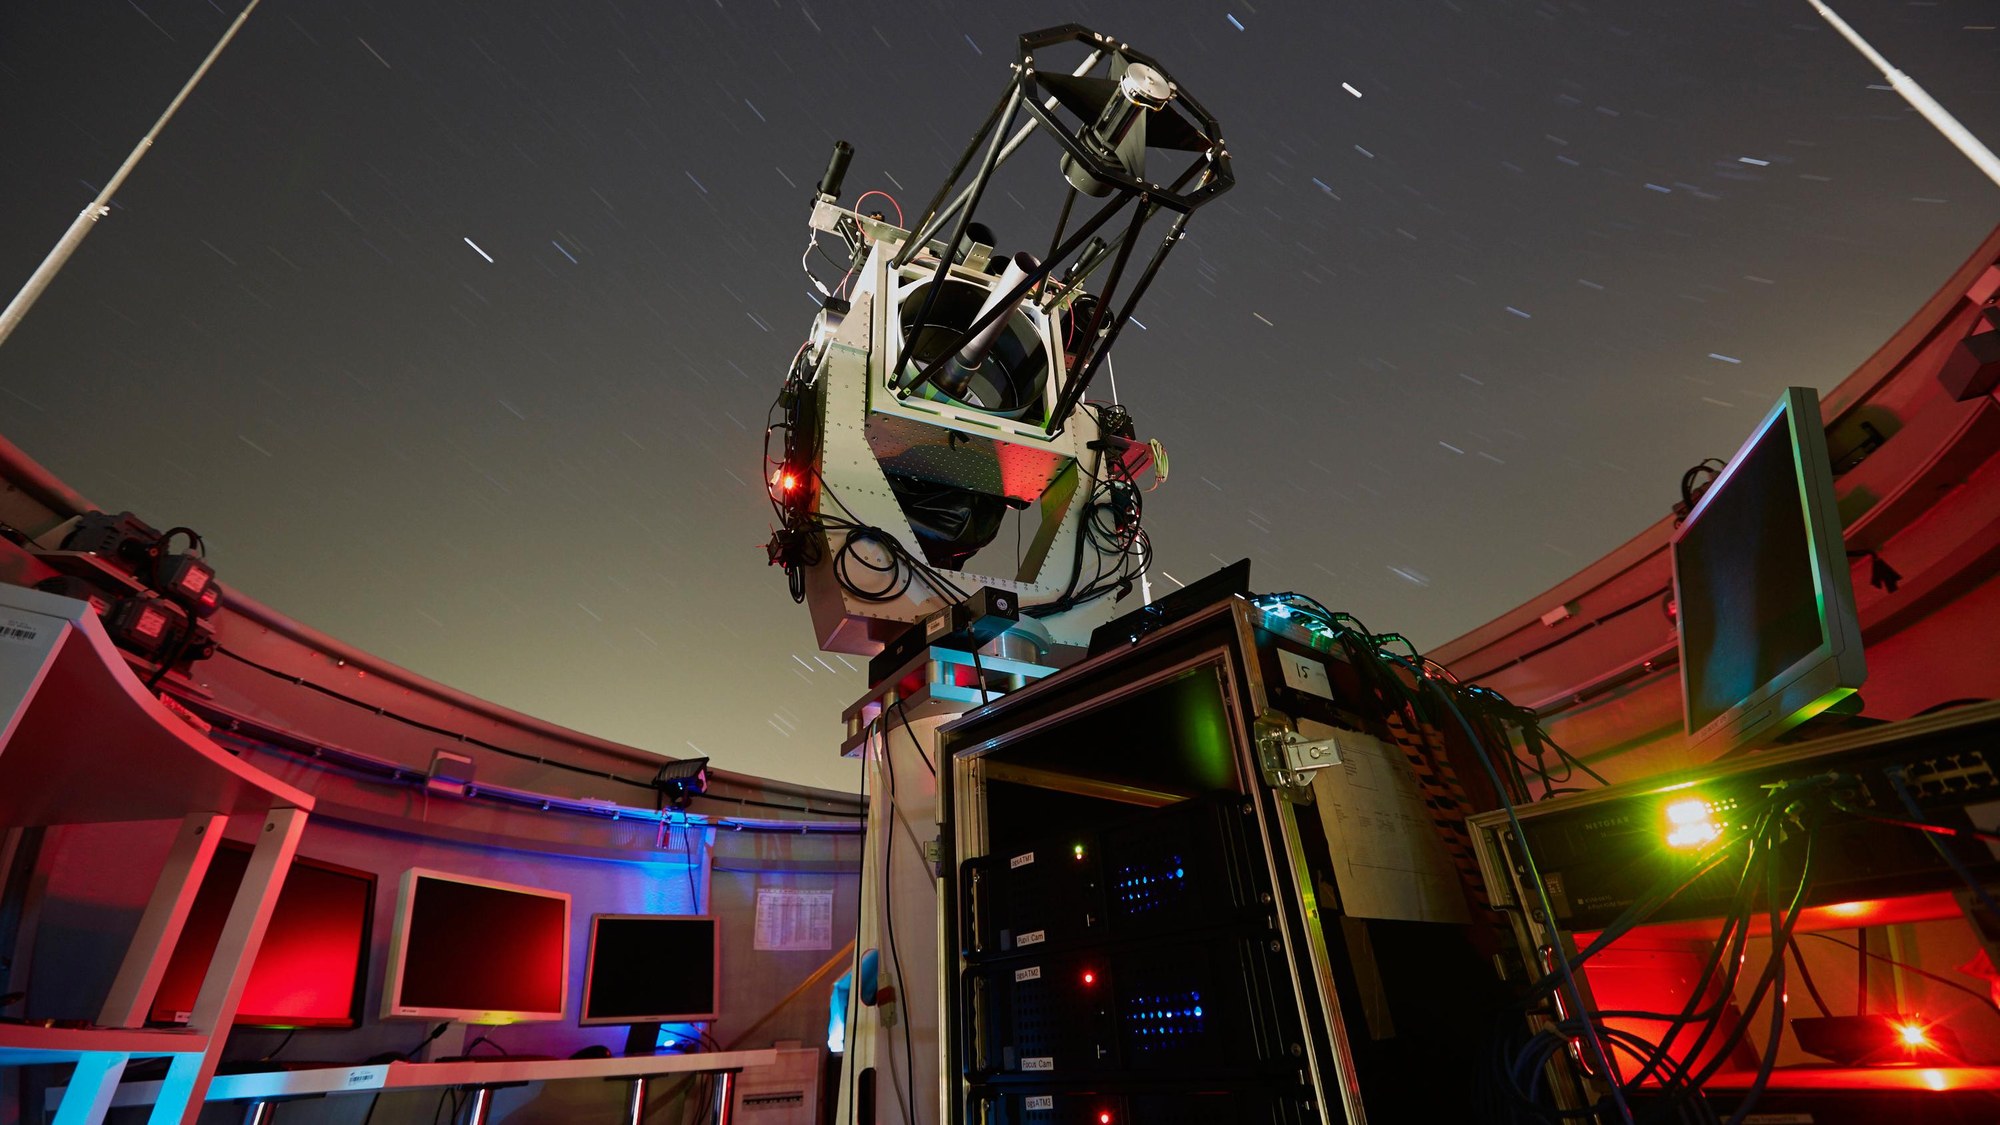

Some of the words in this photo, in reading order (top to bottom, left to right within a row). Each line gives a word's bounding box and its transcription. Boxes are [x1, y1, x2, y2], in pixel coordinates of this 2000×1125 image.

[1295, 662, 1310, 679] 15
[1584, 816, 1630, 831] NETGEAR
[1030, 933, 1044, 942] Cam
[1038, 1059, 1052, 1068] Cam
